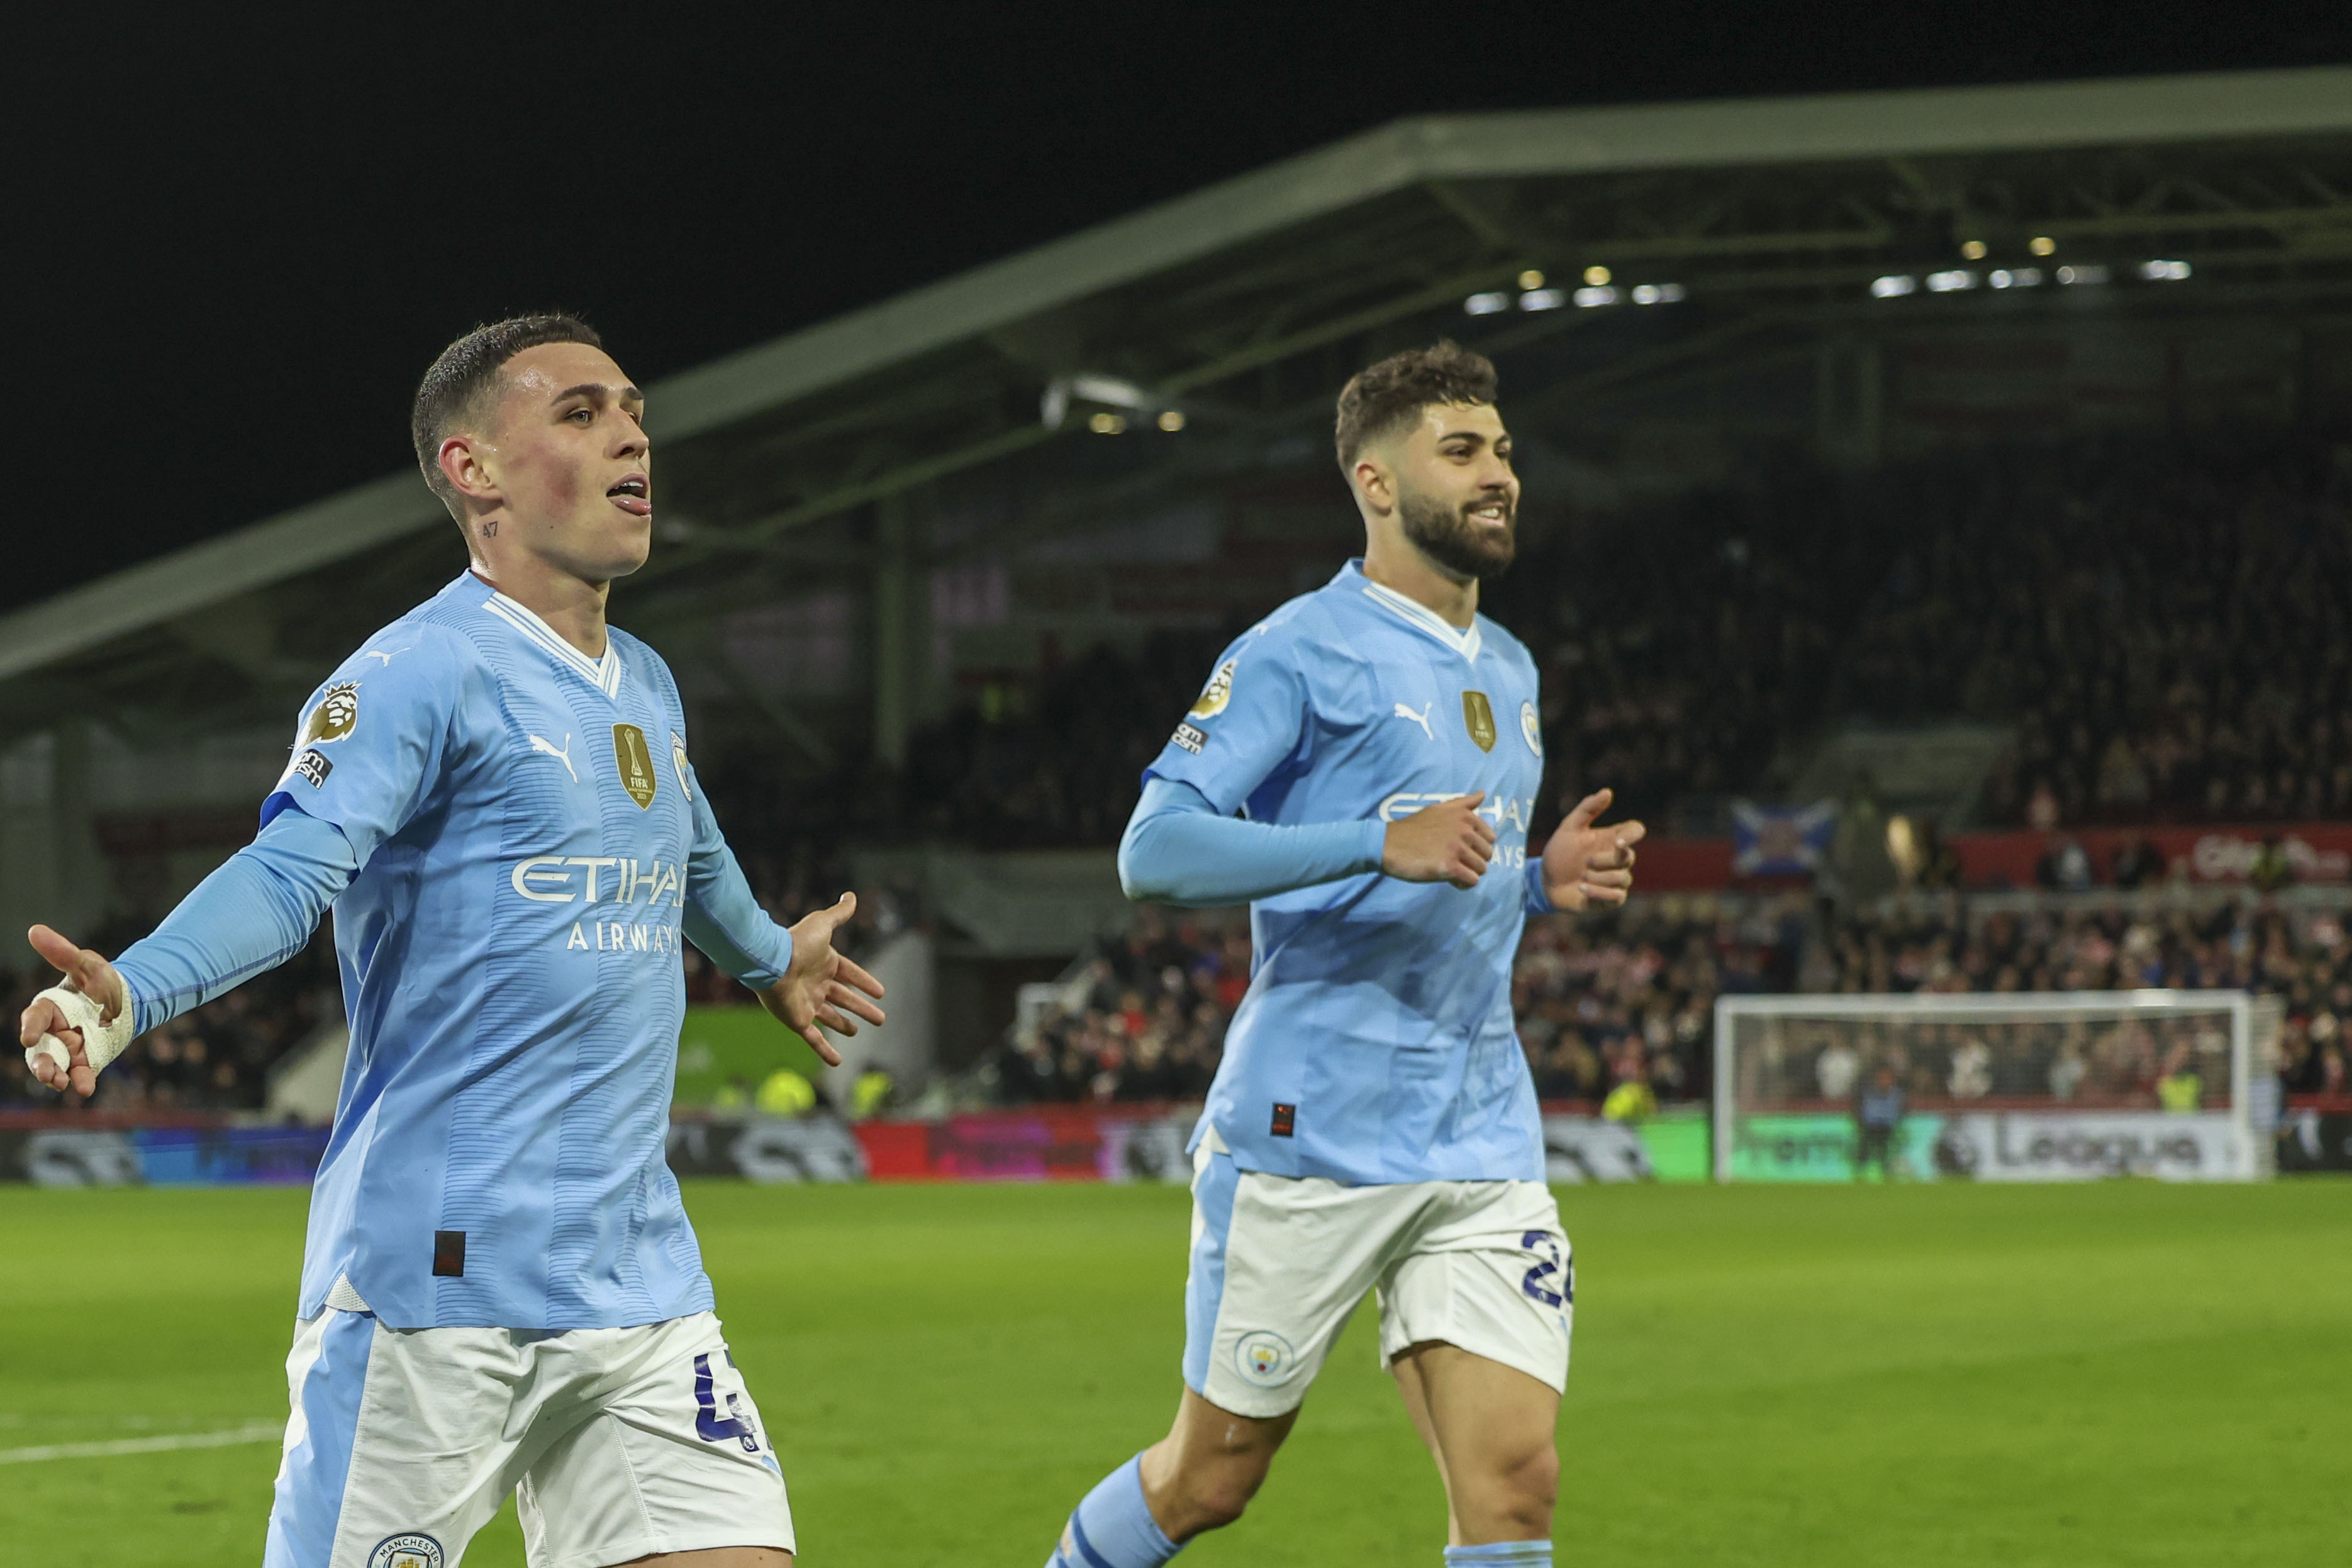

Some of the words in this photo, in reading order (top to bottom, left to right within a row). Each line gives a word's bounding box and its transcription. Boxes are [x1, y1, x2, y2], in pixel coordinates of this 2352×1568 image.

[482, 520, 498, 538] 47
[630, 777, 649, 789] FIFA
[567, 921, 679, 955] AIRWAYS
[1995, 1113, 2202, 1174] League
[1522, 1230, 1573, 1308] 2
[694, 1350, 774, 1452] 4
[379, 1538, 439, 1563] MANCHESTER
